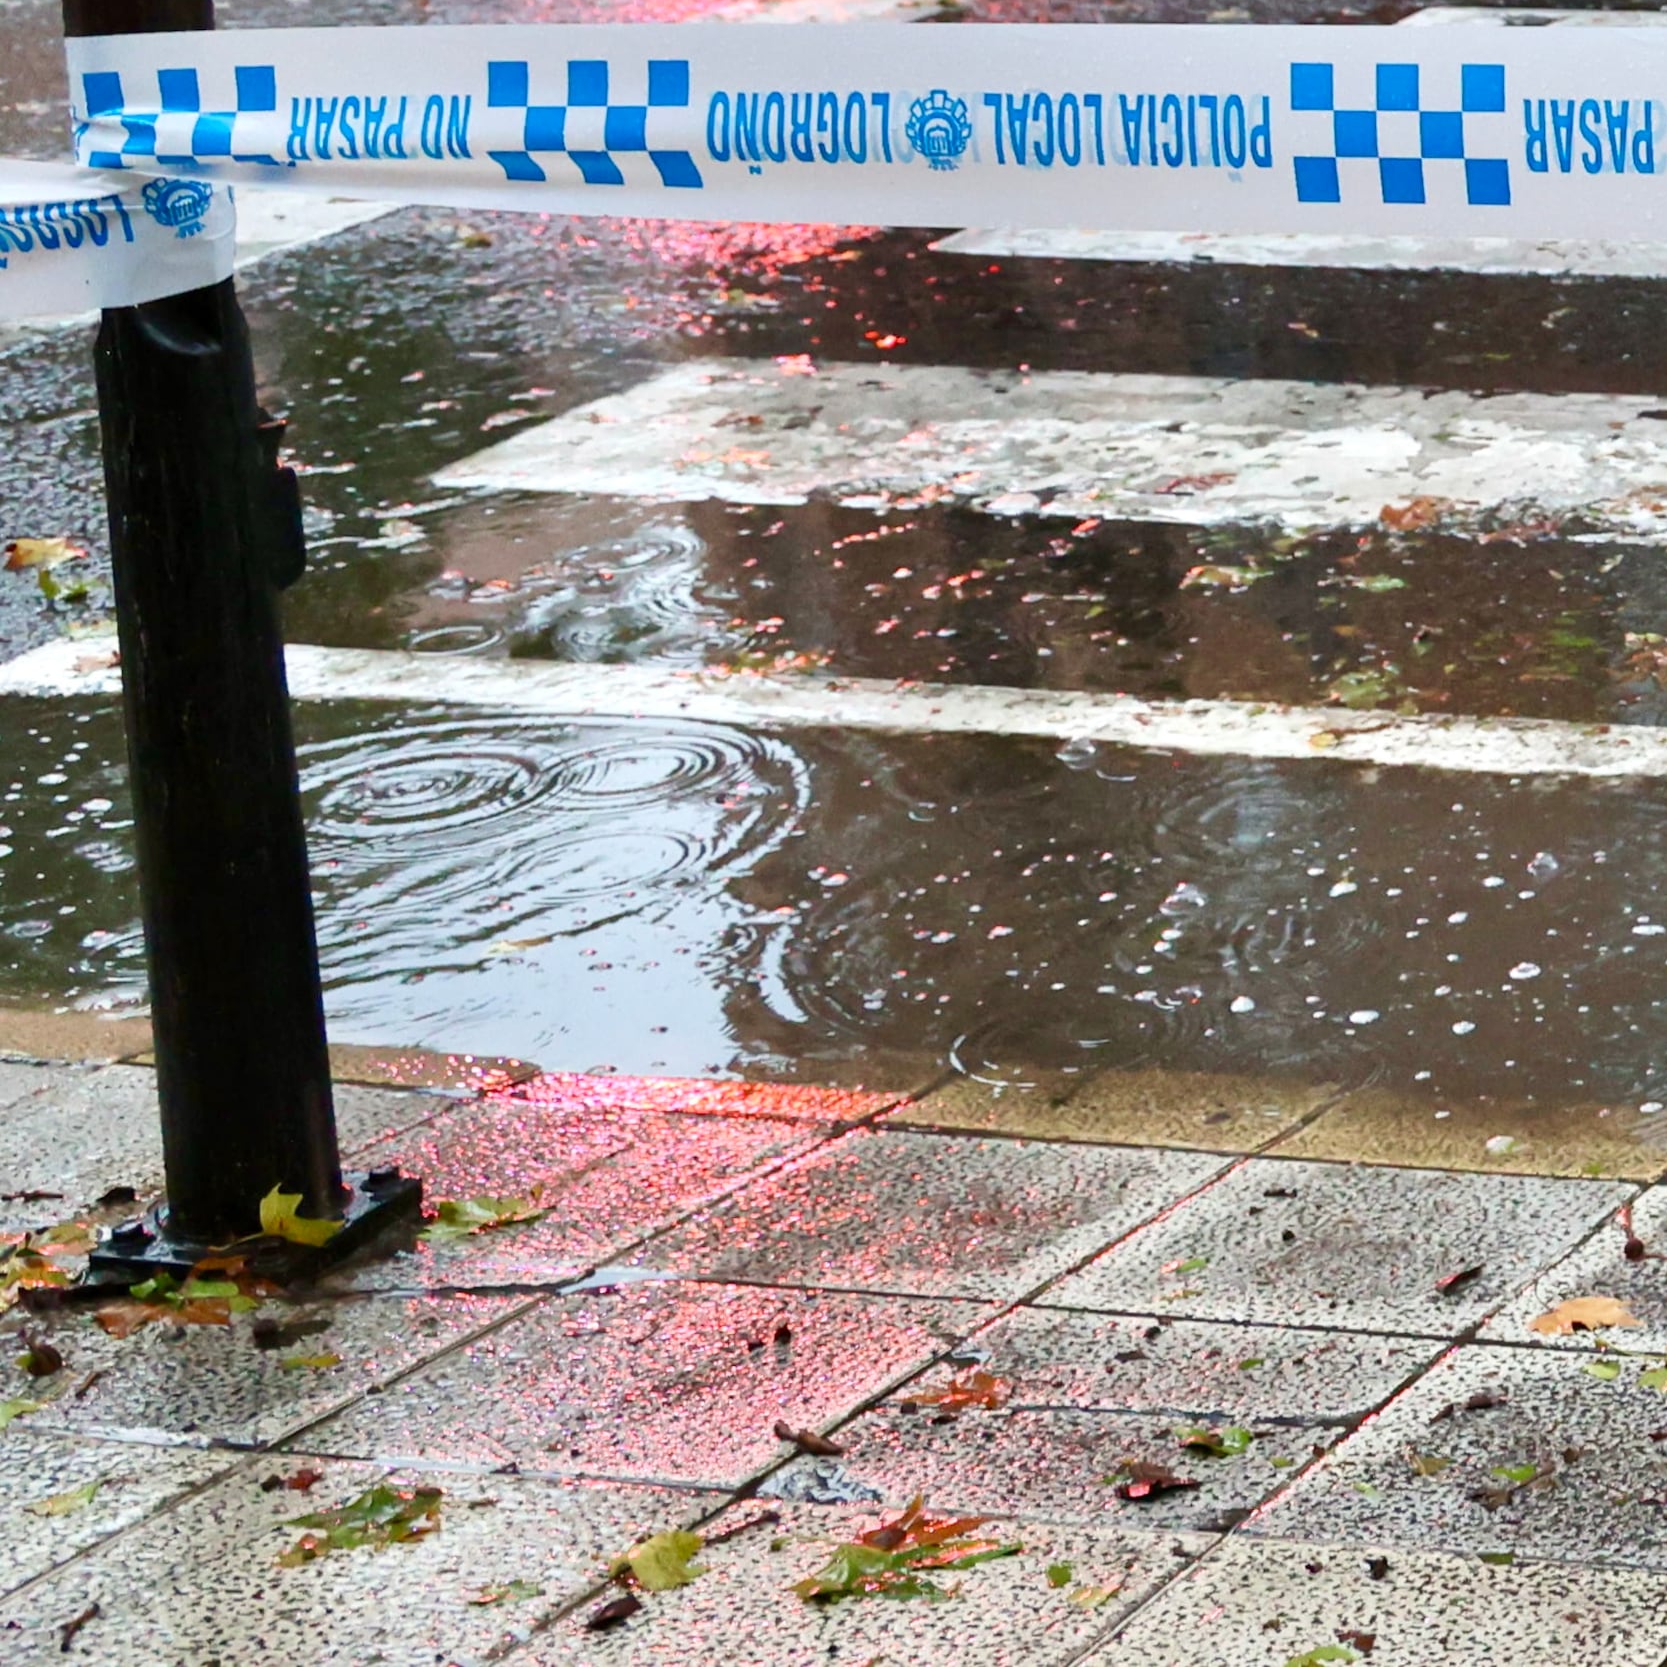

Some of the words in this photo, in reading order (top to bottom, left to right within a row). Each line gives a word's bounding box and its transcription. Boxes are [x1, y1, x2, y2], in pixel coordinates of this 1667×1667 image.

[287, 96, 408, 167] PASAR
[421, 95, 471, 159] NO
[707, 91, 892, 174] LOGROÑO
[984, 92, 1102, 167] LOCAL
[1119, 94, 1272, 168] POLICIA
[1524, 99, 1655, 174] PASAR
[0, 196, 134, 269] LOGRO
